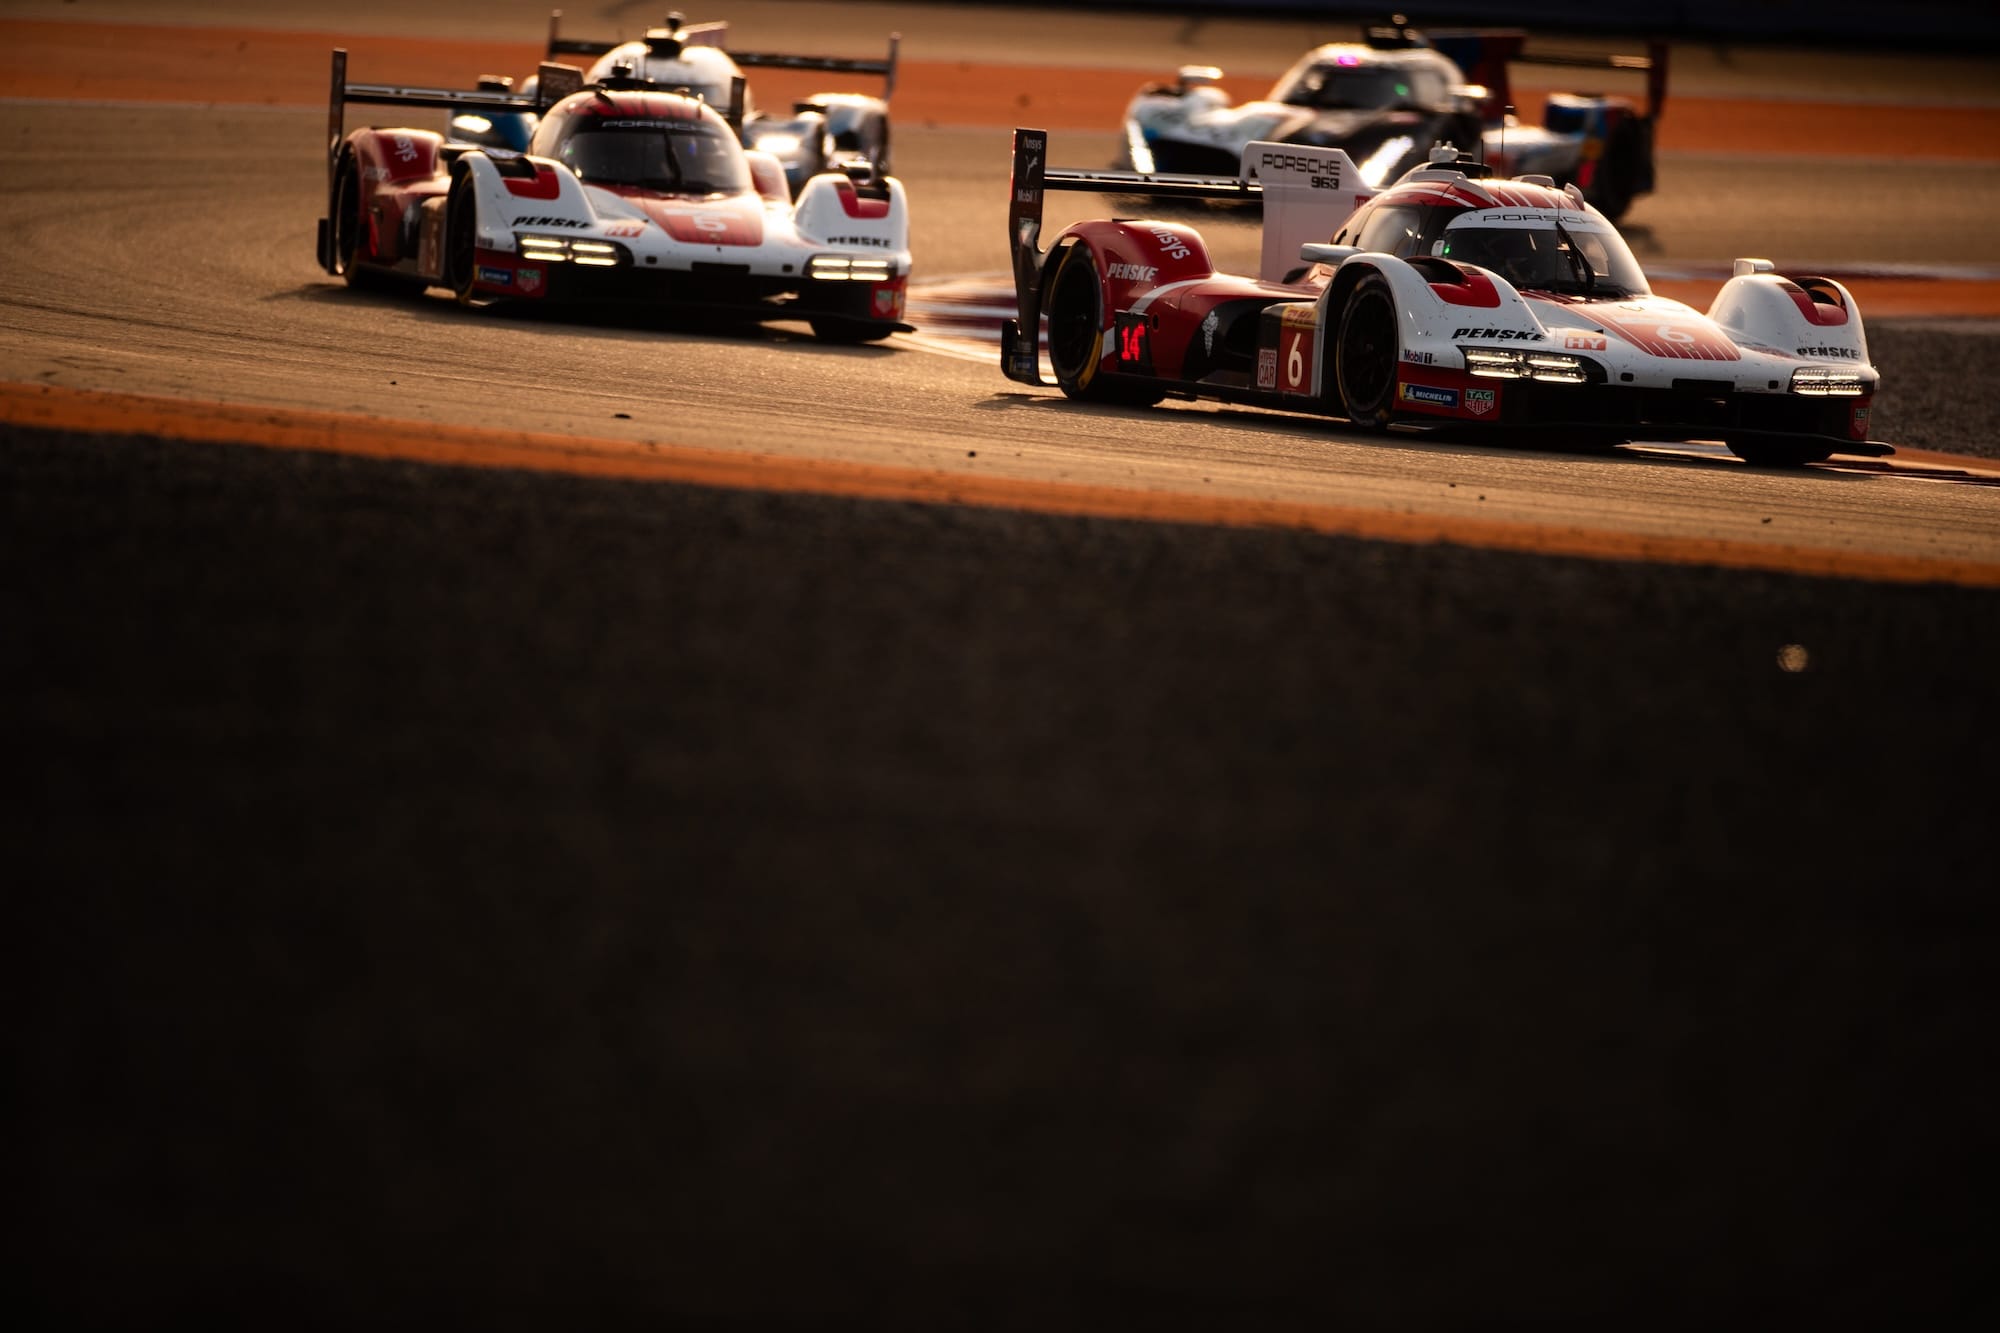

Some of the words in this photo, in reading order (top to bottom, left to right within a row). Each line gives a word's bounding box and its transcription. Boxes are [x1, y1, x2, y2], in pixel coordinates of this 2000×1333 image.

[1262, 153, 1342, 176] PORSCHE
[1311, 176, 1339, 190] 963
[1483, 214, 1598, 226] PORSCH
[1107, 262, 1159, 282] PENSKE
[1121, 323, 1146, 361] 14
[1451, 328, 1546, 342] PENSKE
[1656, 326, 1696, 344] 6
[1566, 337, 1607, 351] HY
[1404, 348, 1424, 363] Mobil
[1796, 346, 1861, 359] PENSKE
[1287, 332, 1303, 388] 6
[1258, 365, 1275, 385] CAR
[1415, 390, 1453, 402] MICHELIN
[1467, 390, 1493, 400] TAG
[1466, 399, 1494, 412] HEUER
